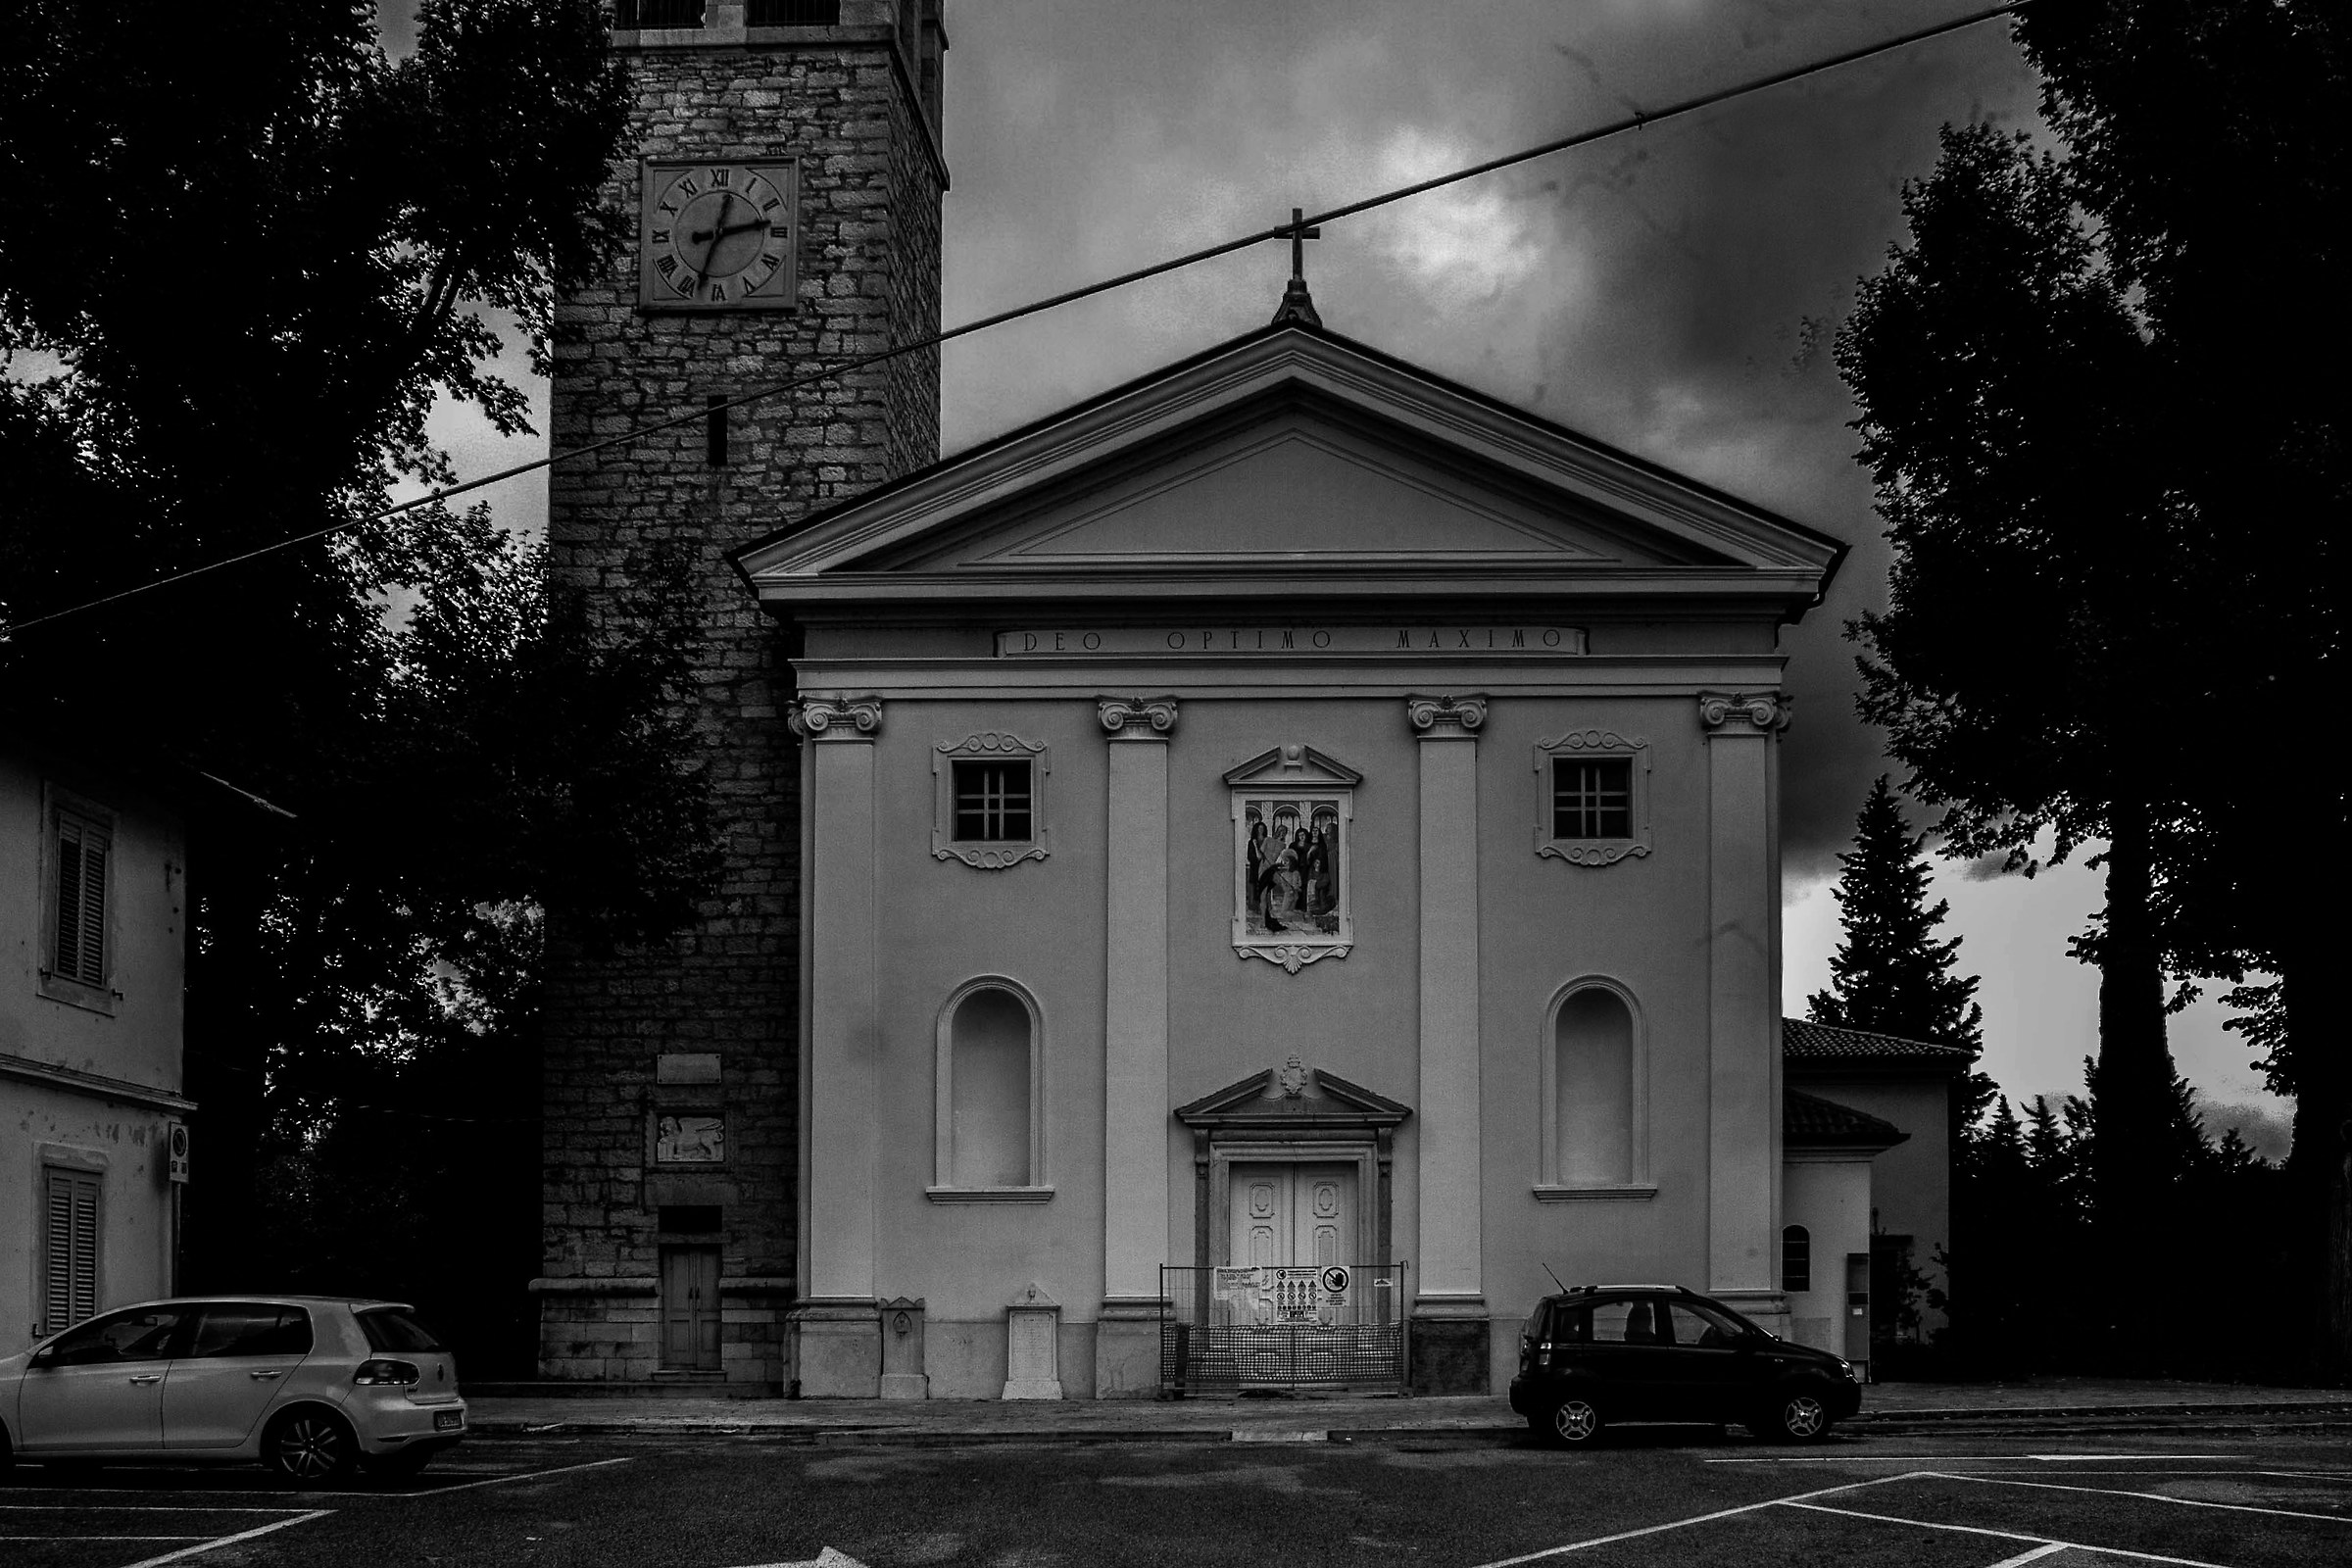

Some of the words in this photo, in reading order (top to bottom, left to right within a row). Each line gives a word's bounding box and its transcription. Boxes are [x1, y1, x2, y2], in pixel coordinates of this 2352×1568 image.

[710, 169, 729, 187] XII
[746, 177, 757, 194] I
[679, 178, 698, 198] XI
[660, 201, 679, 217] X
[762, 198, 780, 212] II
[652, 229, 670, 244] IX
[770, 227, 788, 238] III
[657, 255, 679, 280] VIII
[761, 254, 780, 271] IV
[677, 275, 696, 298] VII
[712, 284, 726, 301] VI
[743, 276, 757, 295] V
[1024, 630, 1101, 652] DEO
[1167, 629, 1332, 650] OPTIMO
[1396, 628, 1561, 649] MAXIMO
